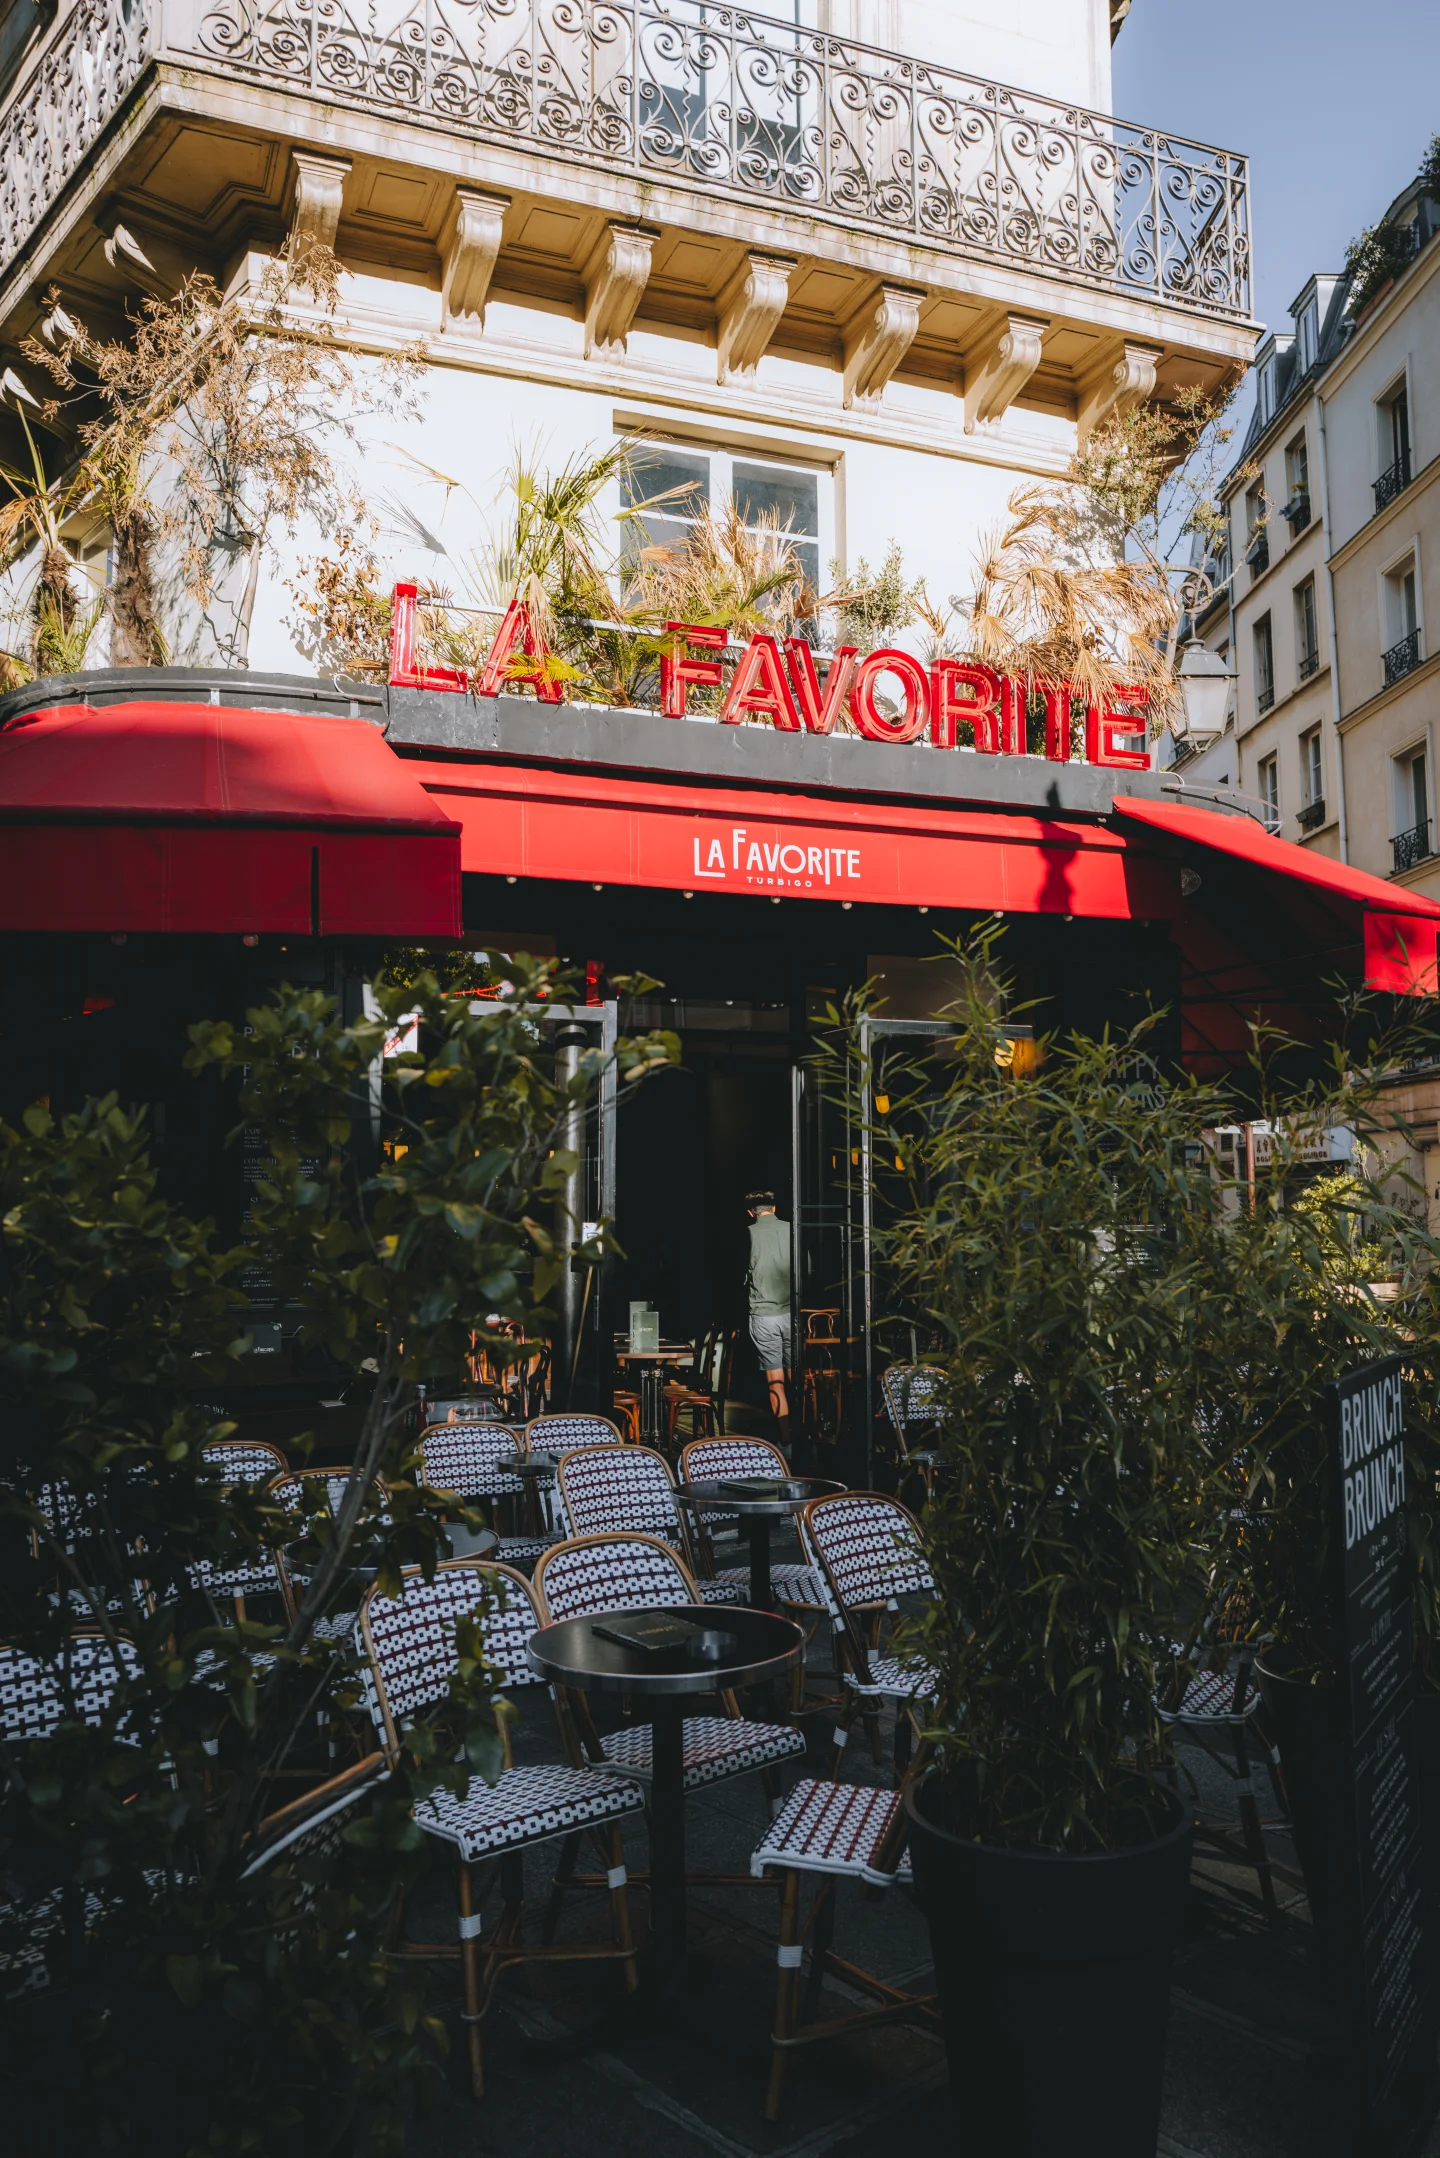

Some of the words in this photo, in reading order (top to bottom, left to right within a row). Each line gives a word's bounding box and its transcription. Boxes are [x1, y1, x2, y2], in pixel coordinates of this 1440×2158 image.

[388, 582, 564, 705] LA
[660, 620, 1152, 771] FAVORITE
[693, 837, 726, 878] LA
[732, 828, 861, 885] FAVORITE
[746, 876, 813, 888] TURBIGO
[1107, 1055, 1160, 1079] APPY
[1341, 1371, 1403, 1470] BRUNCH
[1344, 1440, 1406, 1550] BRUNCH
